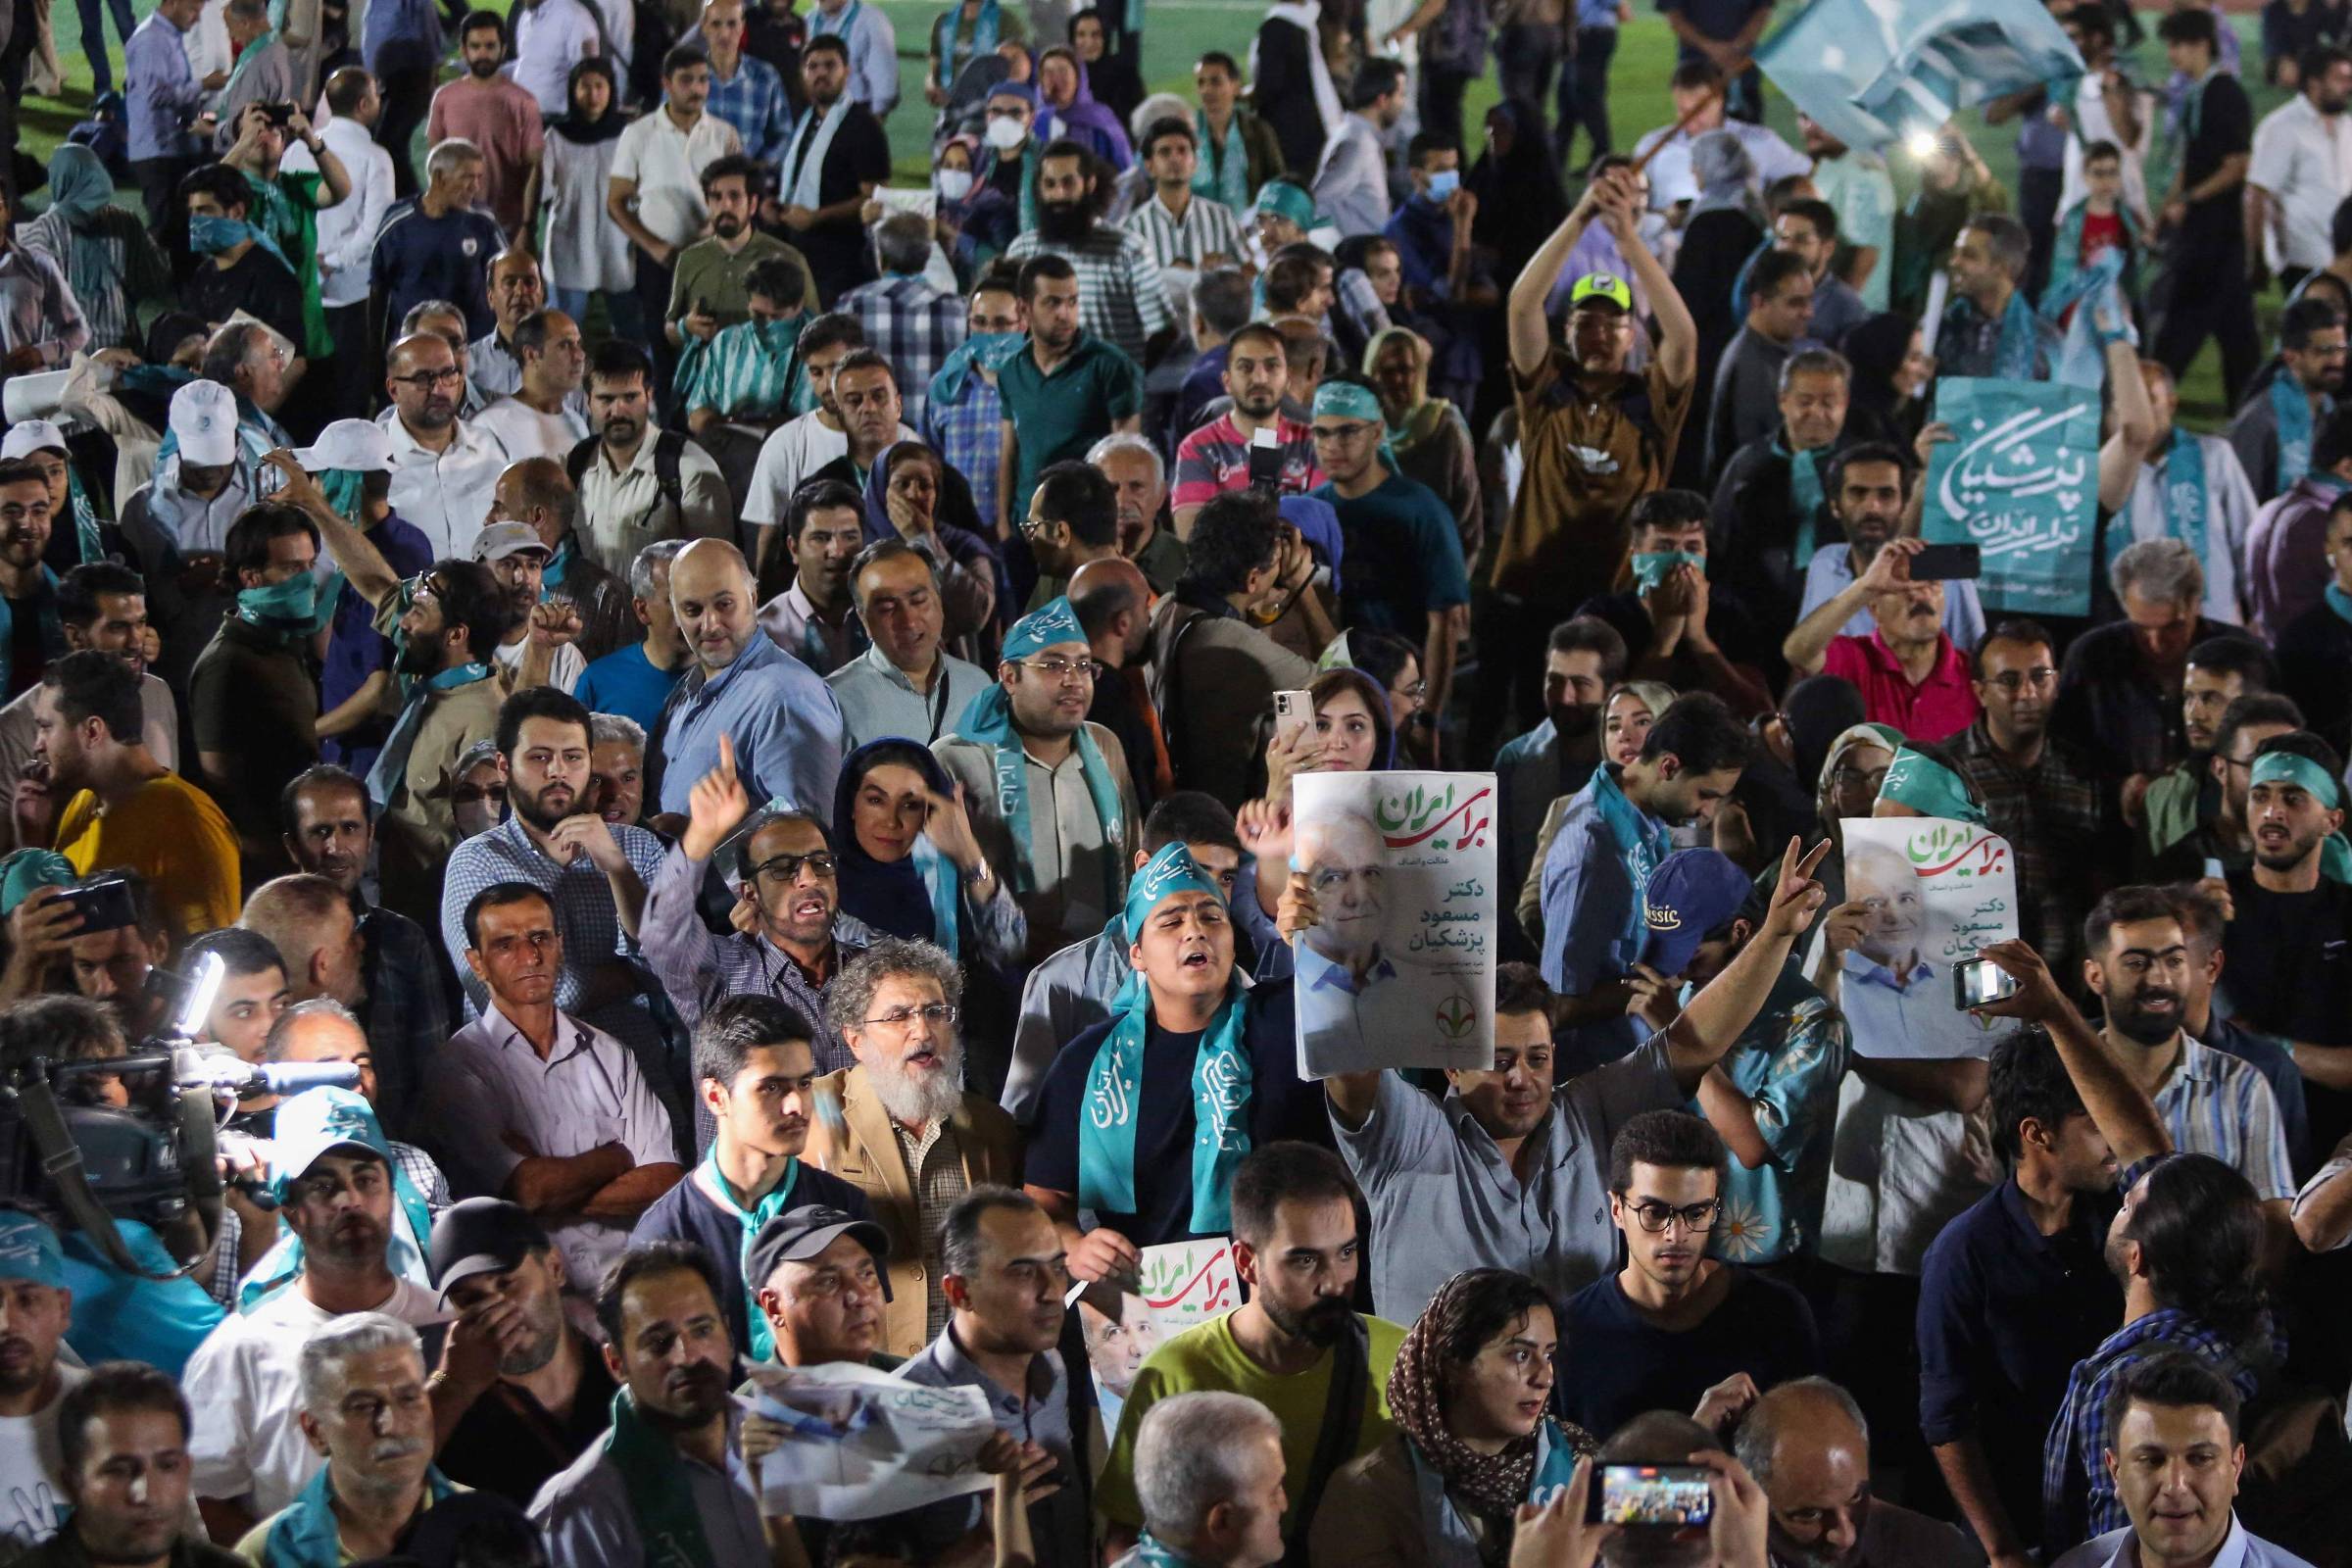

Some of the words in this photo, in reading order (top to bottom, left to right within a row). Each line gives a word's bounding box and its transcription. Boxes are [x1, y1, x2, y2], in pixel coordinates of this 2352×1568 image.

[1939, 403, 2086, 520] پزشکیان
[1376, 782, 1454, 850] ایران
[1383, 788, 1491, 850] برای
[1144, 846, 1194, 901] پزشکیان
[1907, 825, 1973, 876] ایران
[1914, 835, 2005, 876] برای
[1443, 878, 1484, 903] دکتر
[1971, 898, 2006, 917] دکتر
[1420, 909, 1480, 927] مسعود
[1952, 922, 2003, 936] مسعود
[1409, 928, 1485, 956] پزشکیان
[1145, 1249, 1229, 1311] برای
